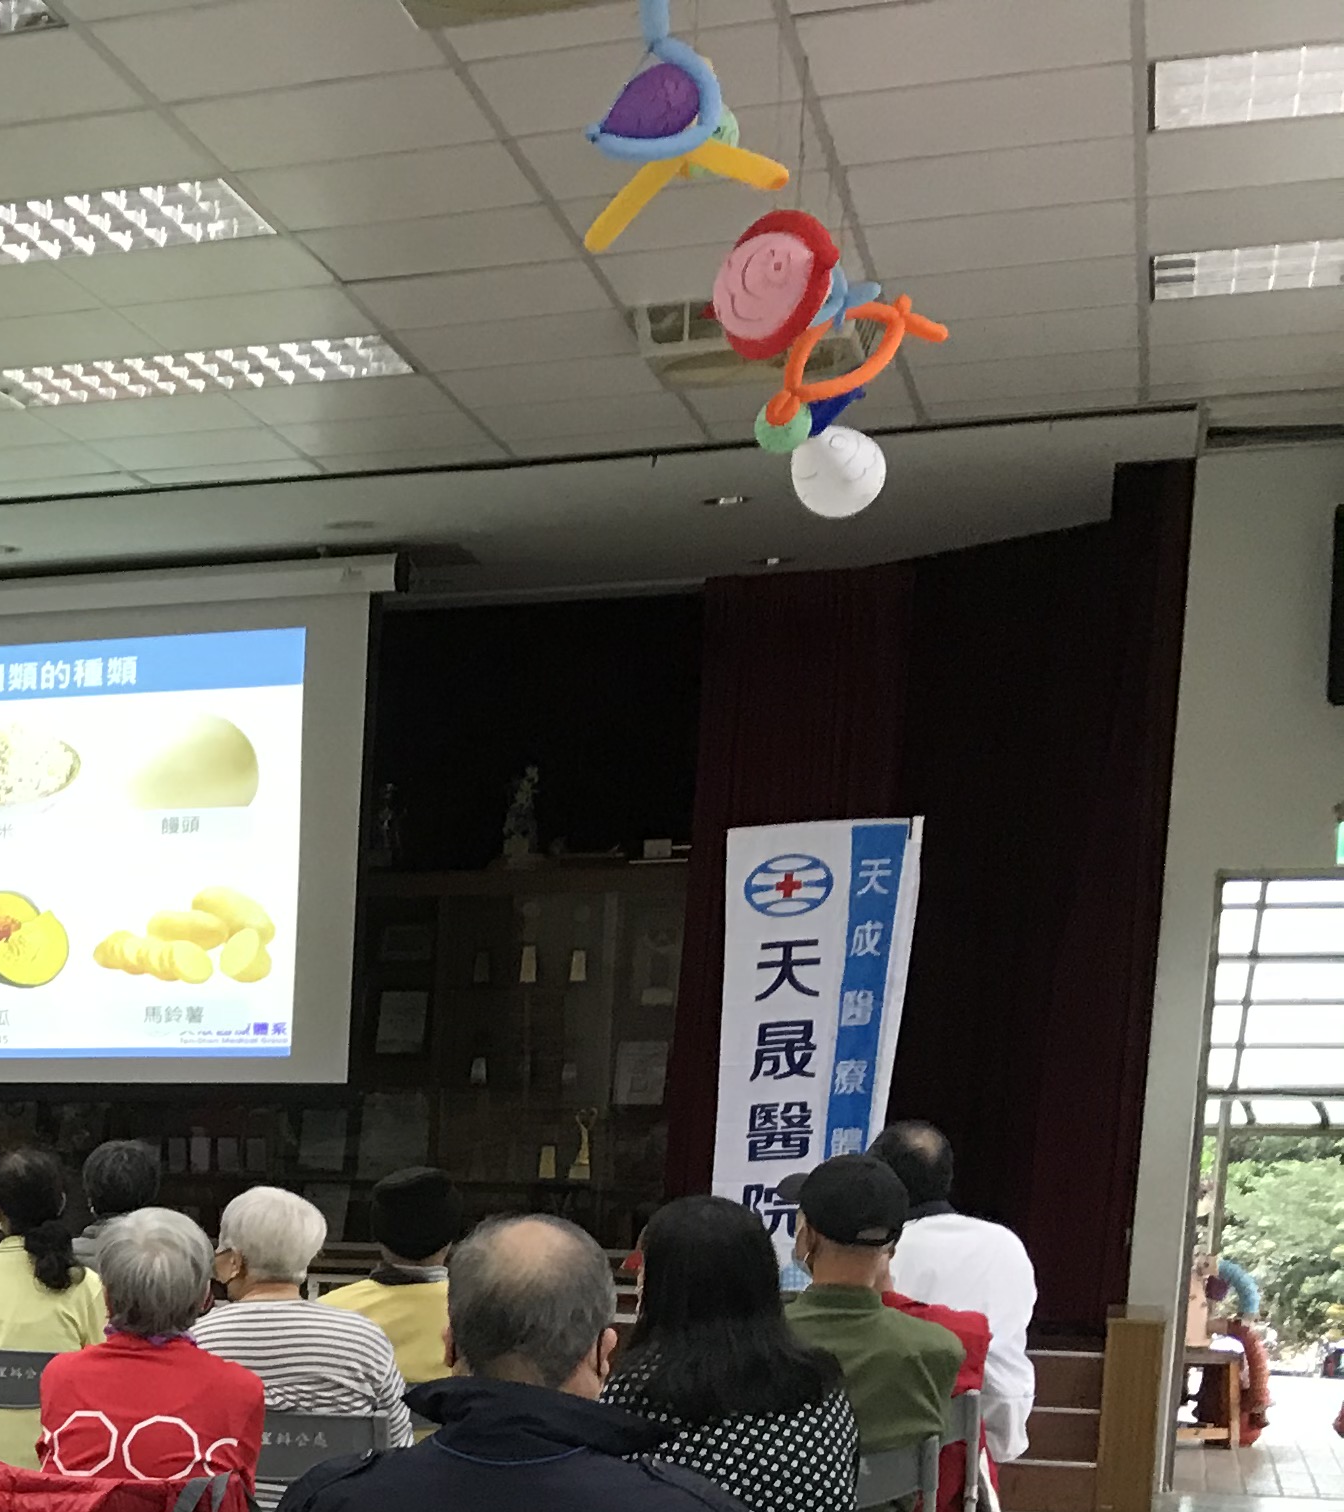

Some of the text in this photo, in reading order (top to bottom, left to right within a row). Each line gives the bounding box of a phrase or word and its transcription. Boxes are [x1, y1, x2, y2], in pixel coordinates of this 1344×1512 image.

[161, 816, 200, 835] 饅頭
[144, 1006, 204, 1024] 馬鈴薯
[742, 938, 821, 1239] 天晟醫院
